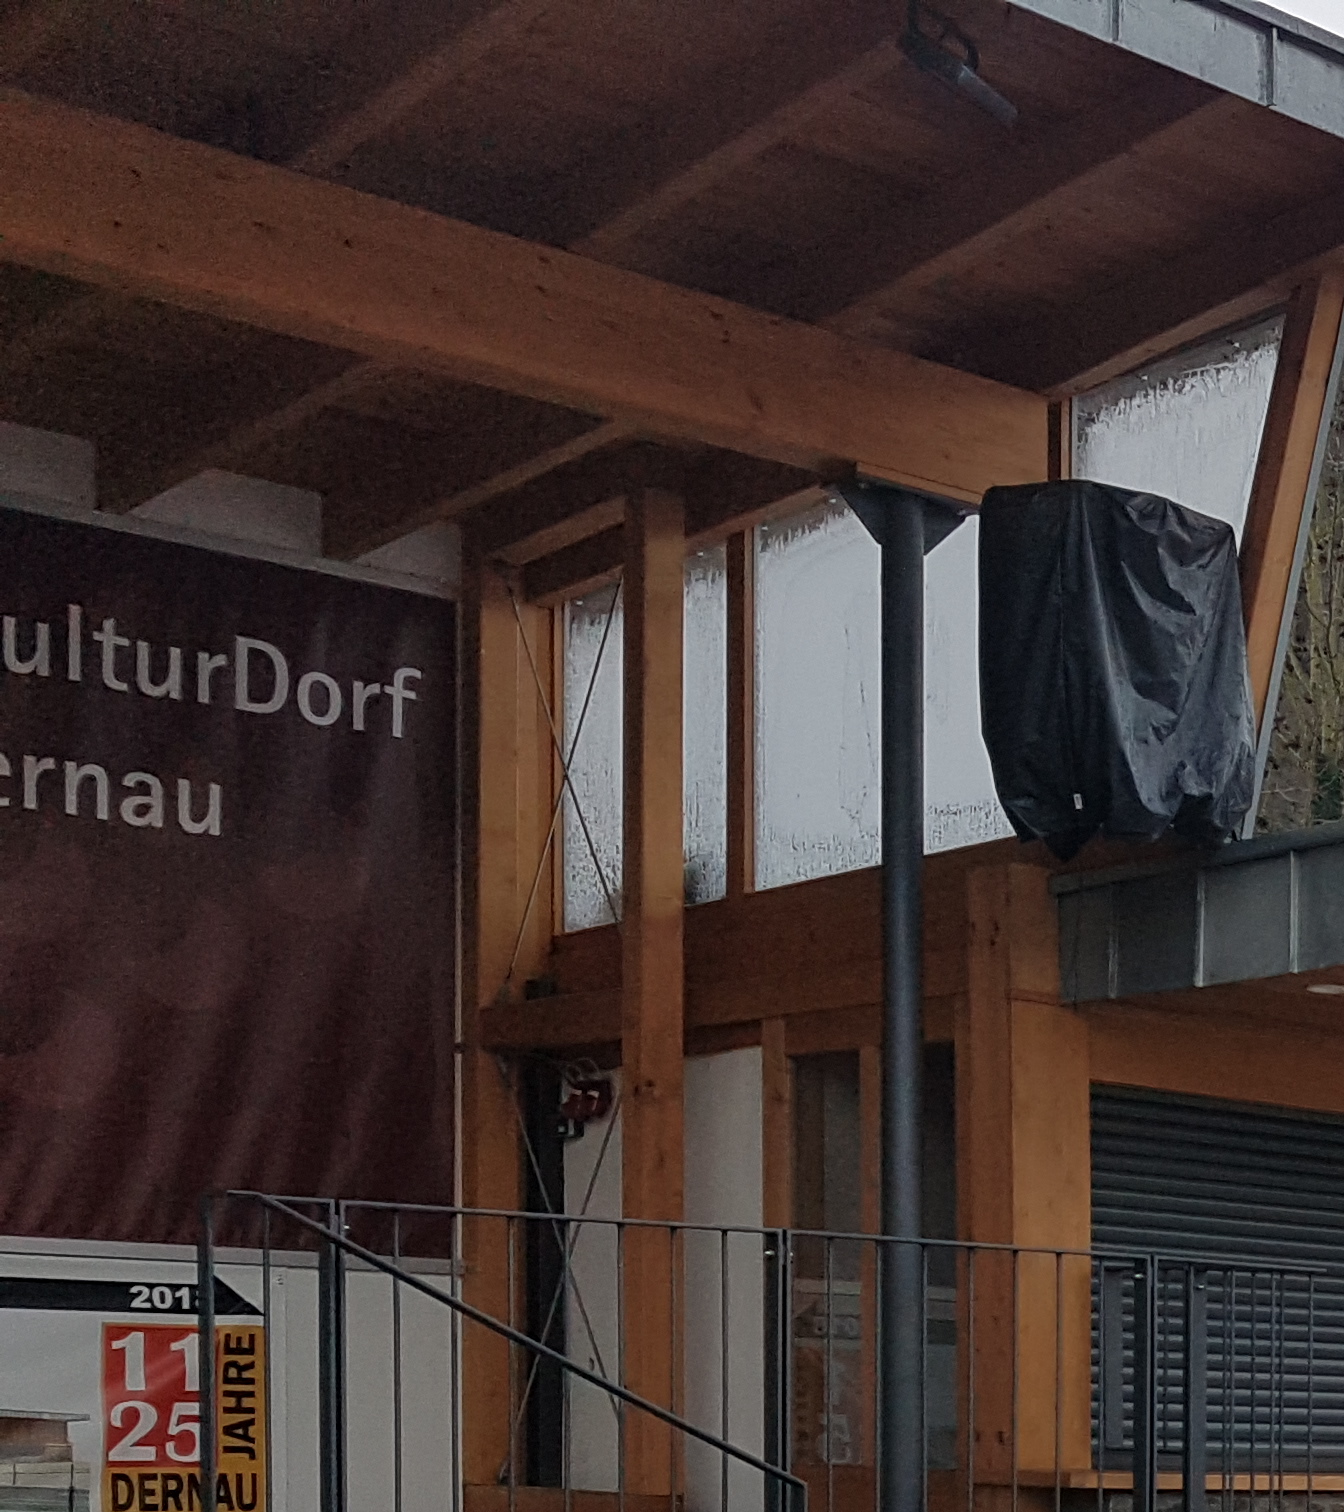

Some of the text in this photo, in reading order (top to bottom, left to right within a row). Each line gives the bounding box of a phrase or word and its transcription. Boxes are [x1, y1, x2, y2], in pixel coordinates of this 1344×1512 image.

[0, 752, 223, 837] rnau
[128, 1285, 201, 1310] 201
[108, 1400, 201, 1462] 25
[222, 1333, 256, 1461] JAHRE
